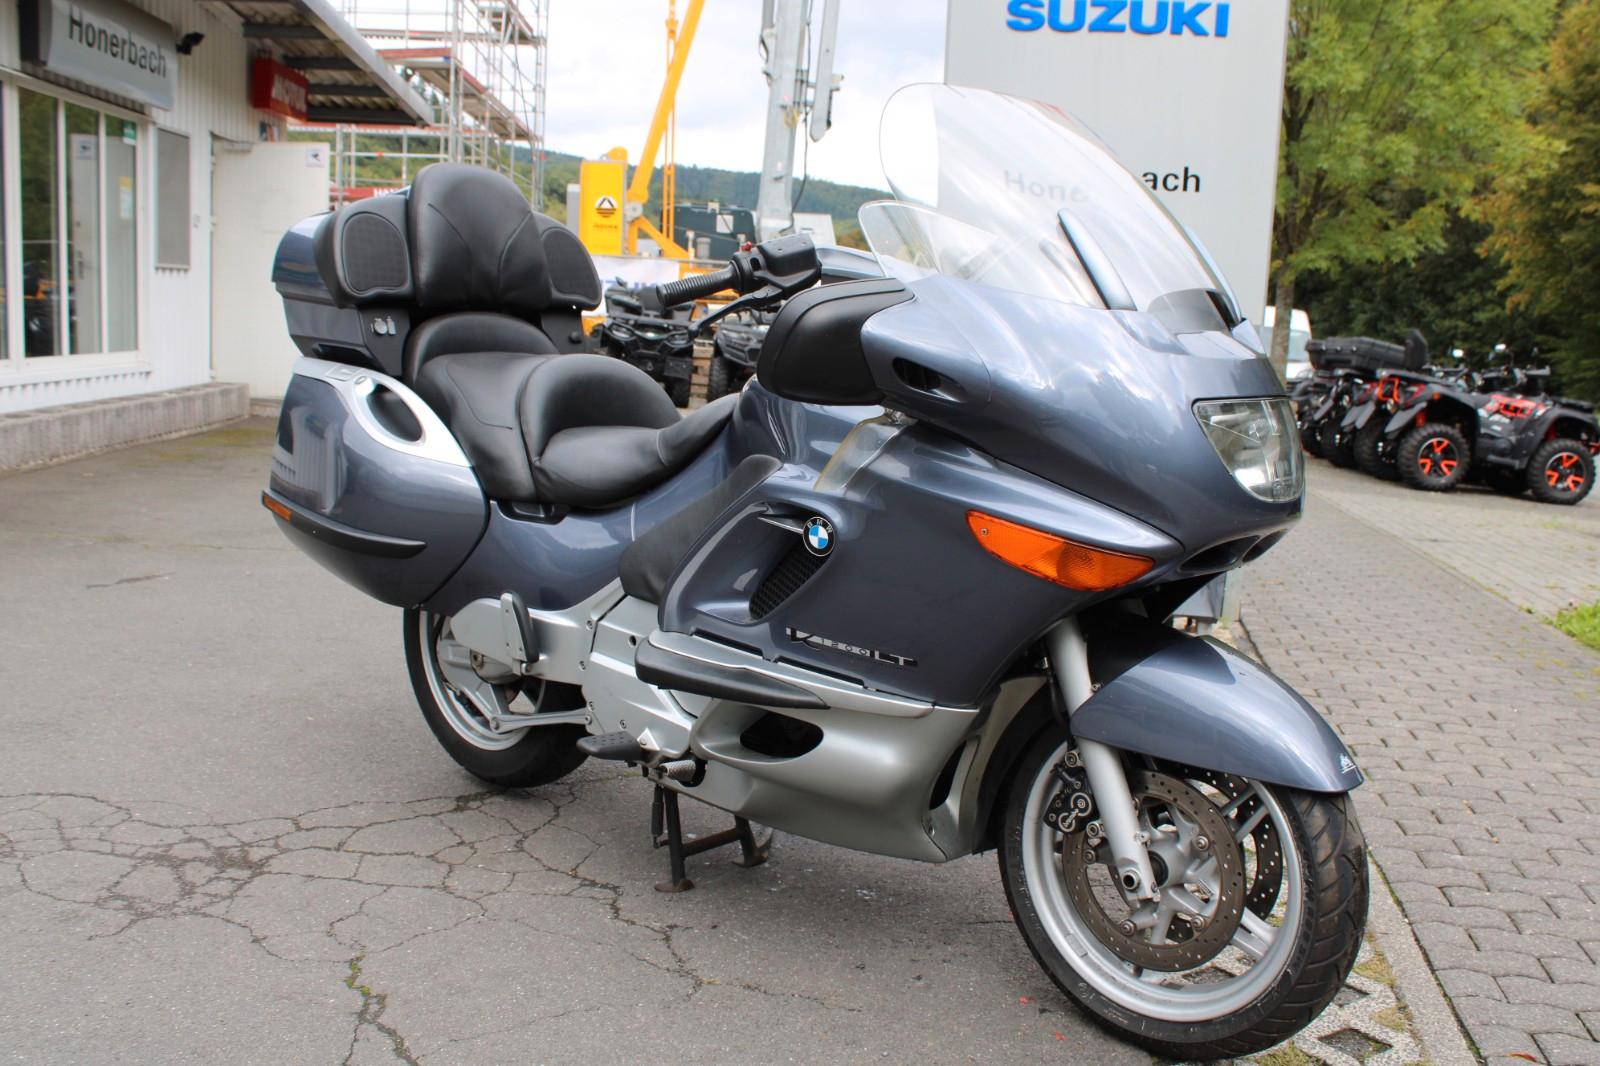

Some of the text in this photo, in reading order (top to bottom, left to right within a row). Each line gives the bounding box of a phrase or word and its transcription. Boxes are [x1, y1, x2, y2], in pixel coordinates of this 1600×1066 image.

[1006, 0, 1230, 37] SUZUKI
[69, 11, 167, 78] Honerbach
[806, 519, 834, 534] BMW
